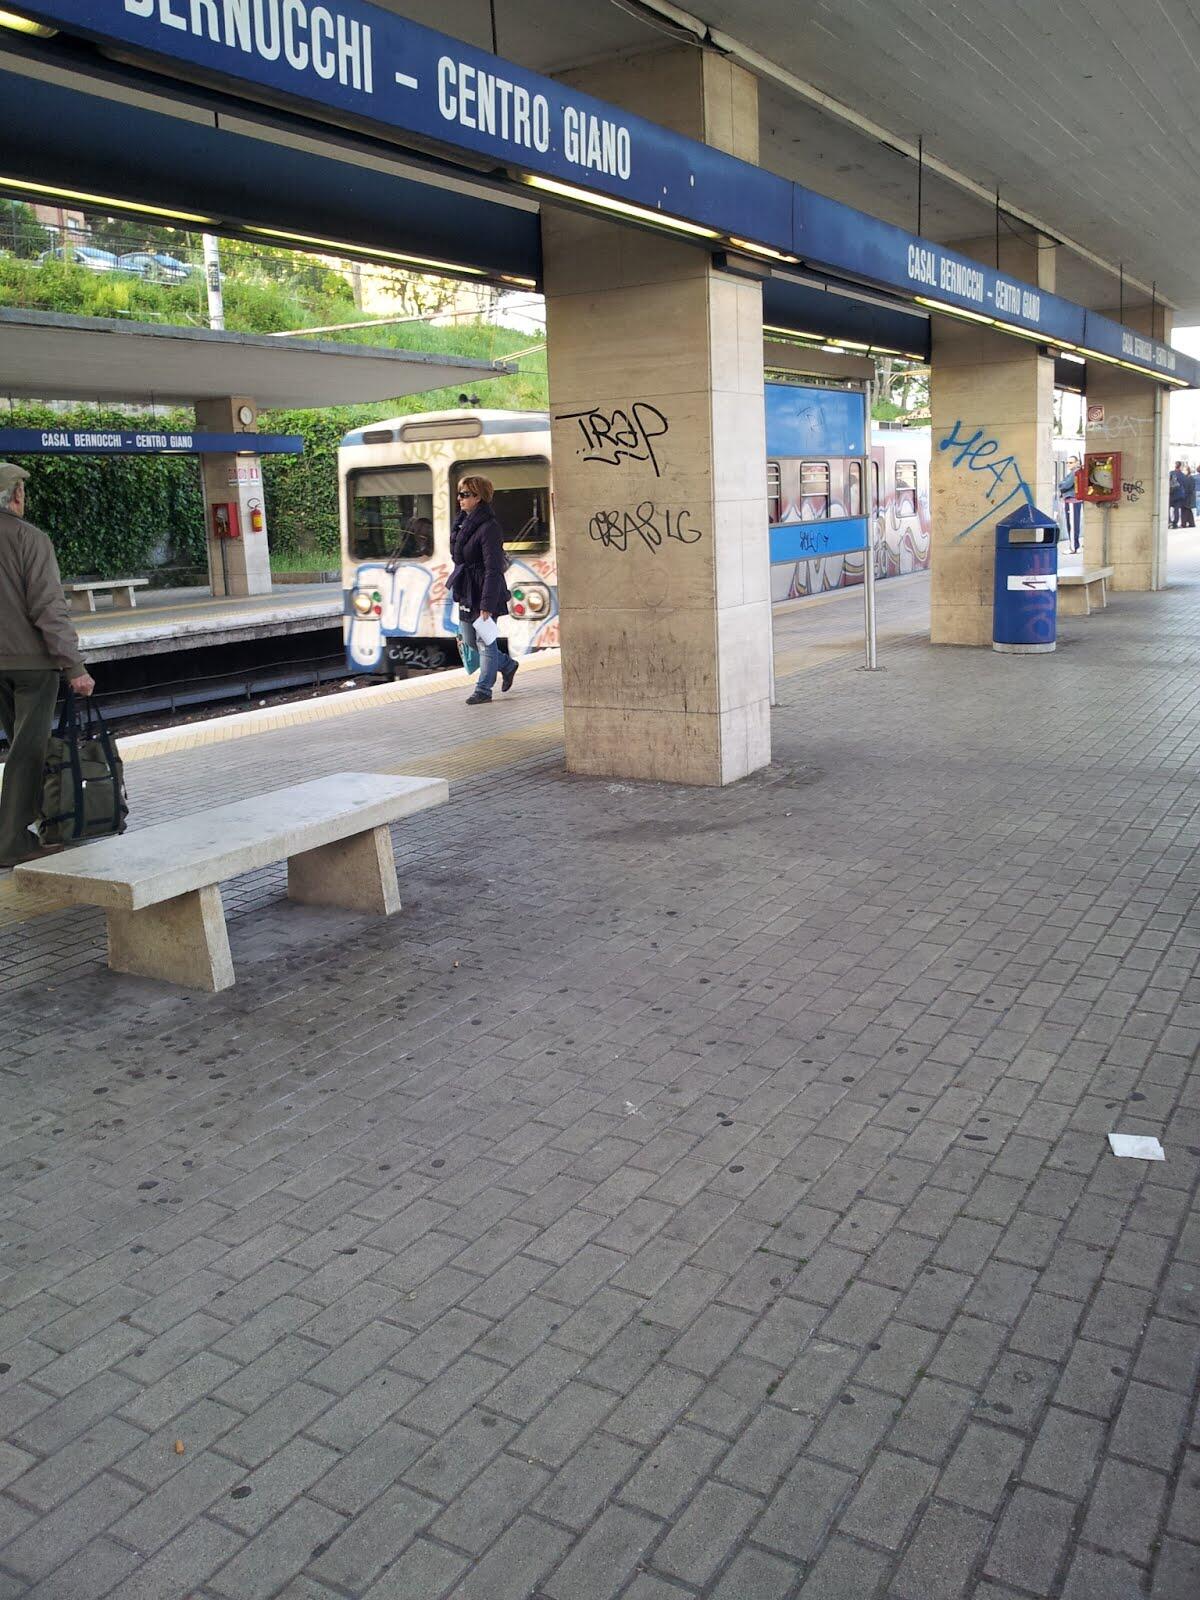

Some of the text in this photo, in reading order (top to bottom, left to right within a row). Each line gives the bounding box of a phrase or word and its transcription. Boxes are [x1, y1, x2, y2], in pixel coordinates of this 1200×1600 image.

[437, 56, 549, 153] CENTRO
[564, 106, 630, 180] GIANO
[908, 244, 937, 286] CASAL
[940, 257, 984, 303] BERNOCCHI
[995, 280, 1020, 315] CENTRO
[1022, 290, 1040, 322] GIANO
[41, 433, 71, 447] CASAL
[74, 433, 122, 447] BERNOCCHI
[136, 435, 167, 447] CENTRO
[170, 435, 193, 448] GIANO
